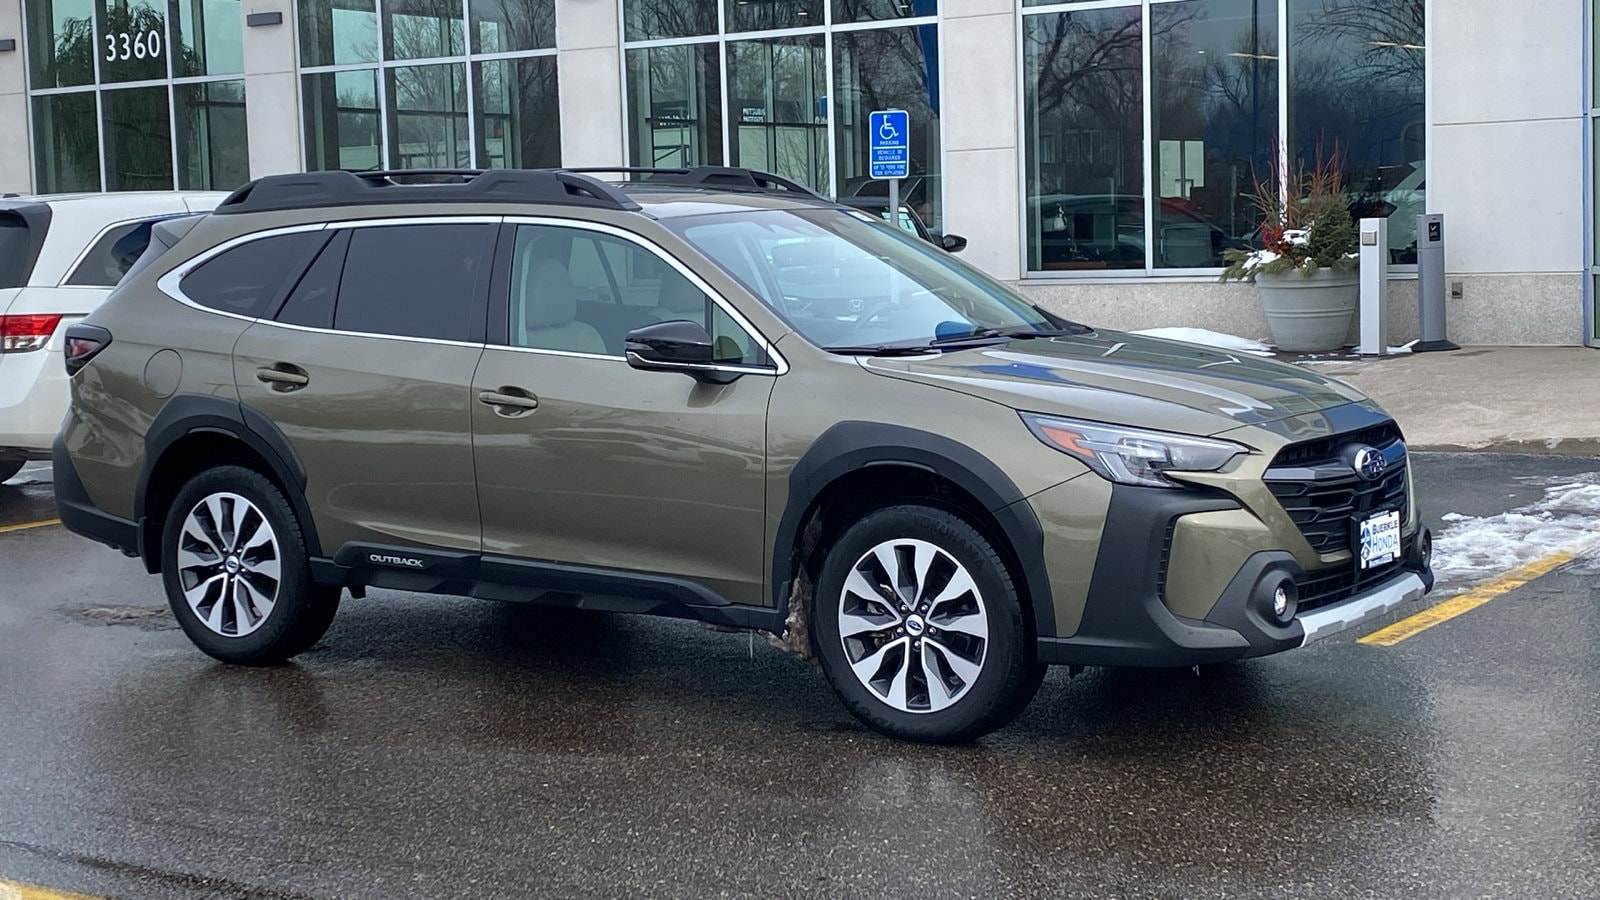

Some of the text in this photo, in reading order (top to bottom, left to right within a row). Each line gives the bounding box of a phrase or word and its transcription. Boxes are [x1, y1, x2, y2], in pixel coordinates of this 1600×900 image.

[105, 30, 160, 61] 3360
[1372, 520, 1398, 535] BUERKLE
[1372, 533, 1398, 552] HONDA
[370, 554, 423, 567] OUTBACK
